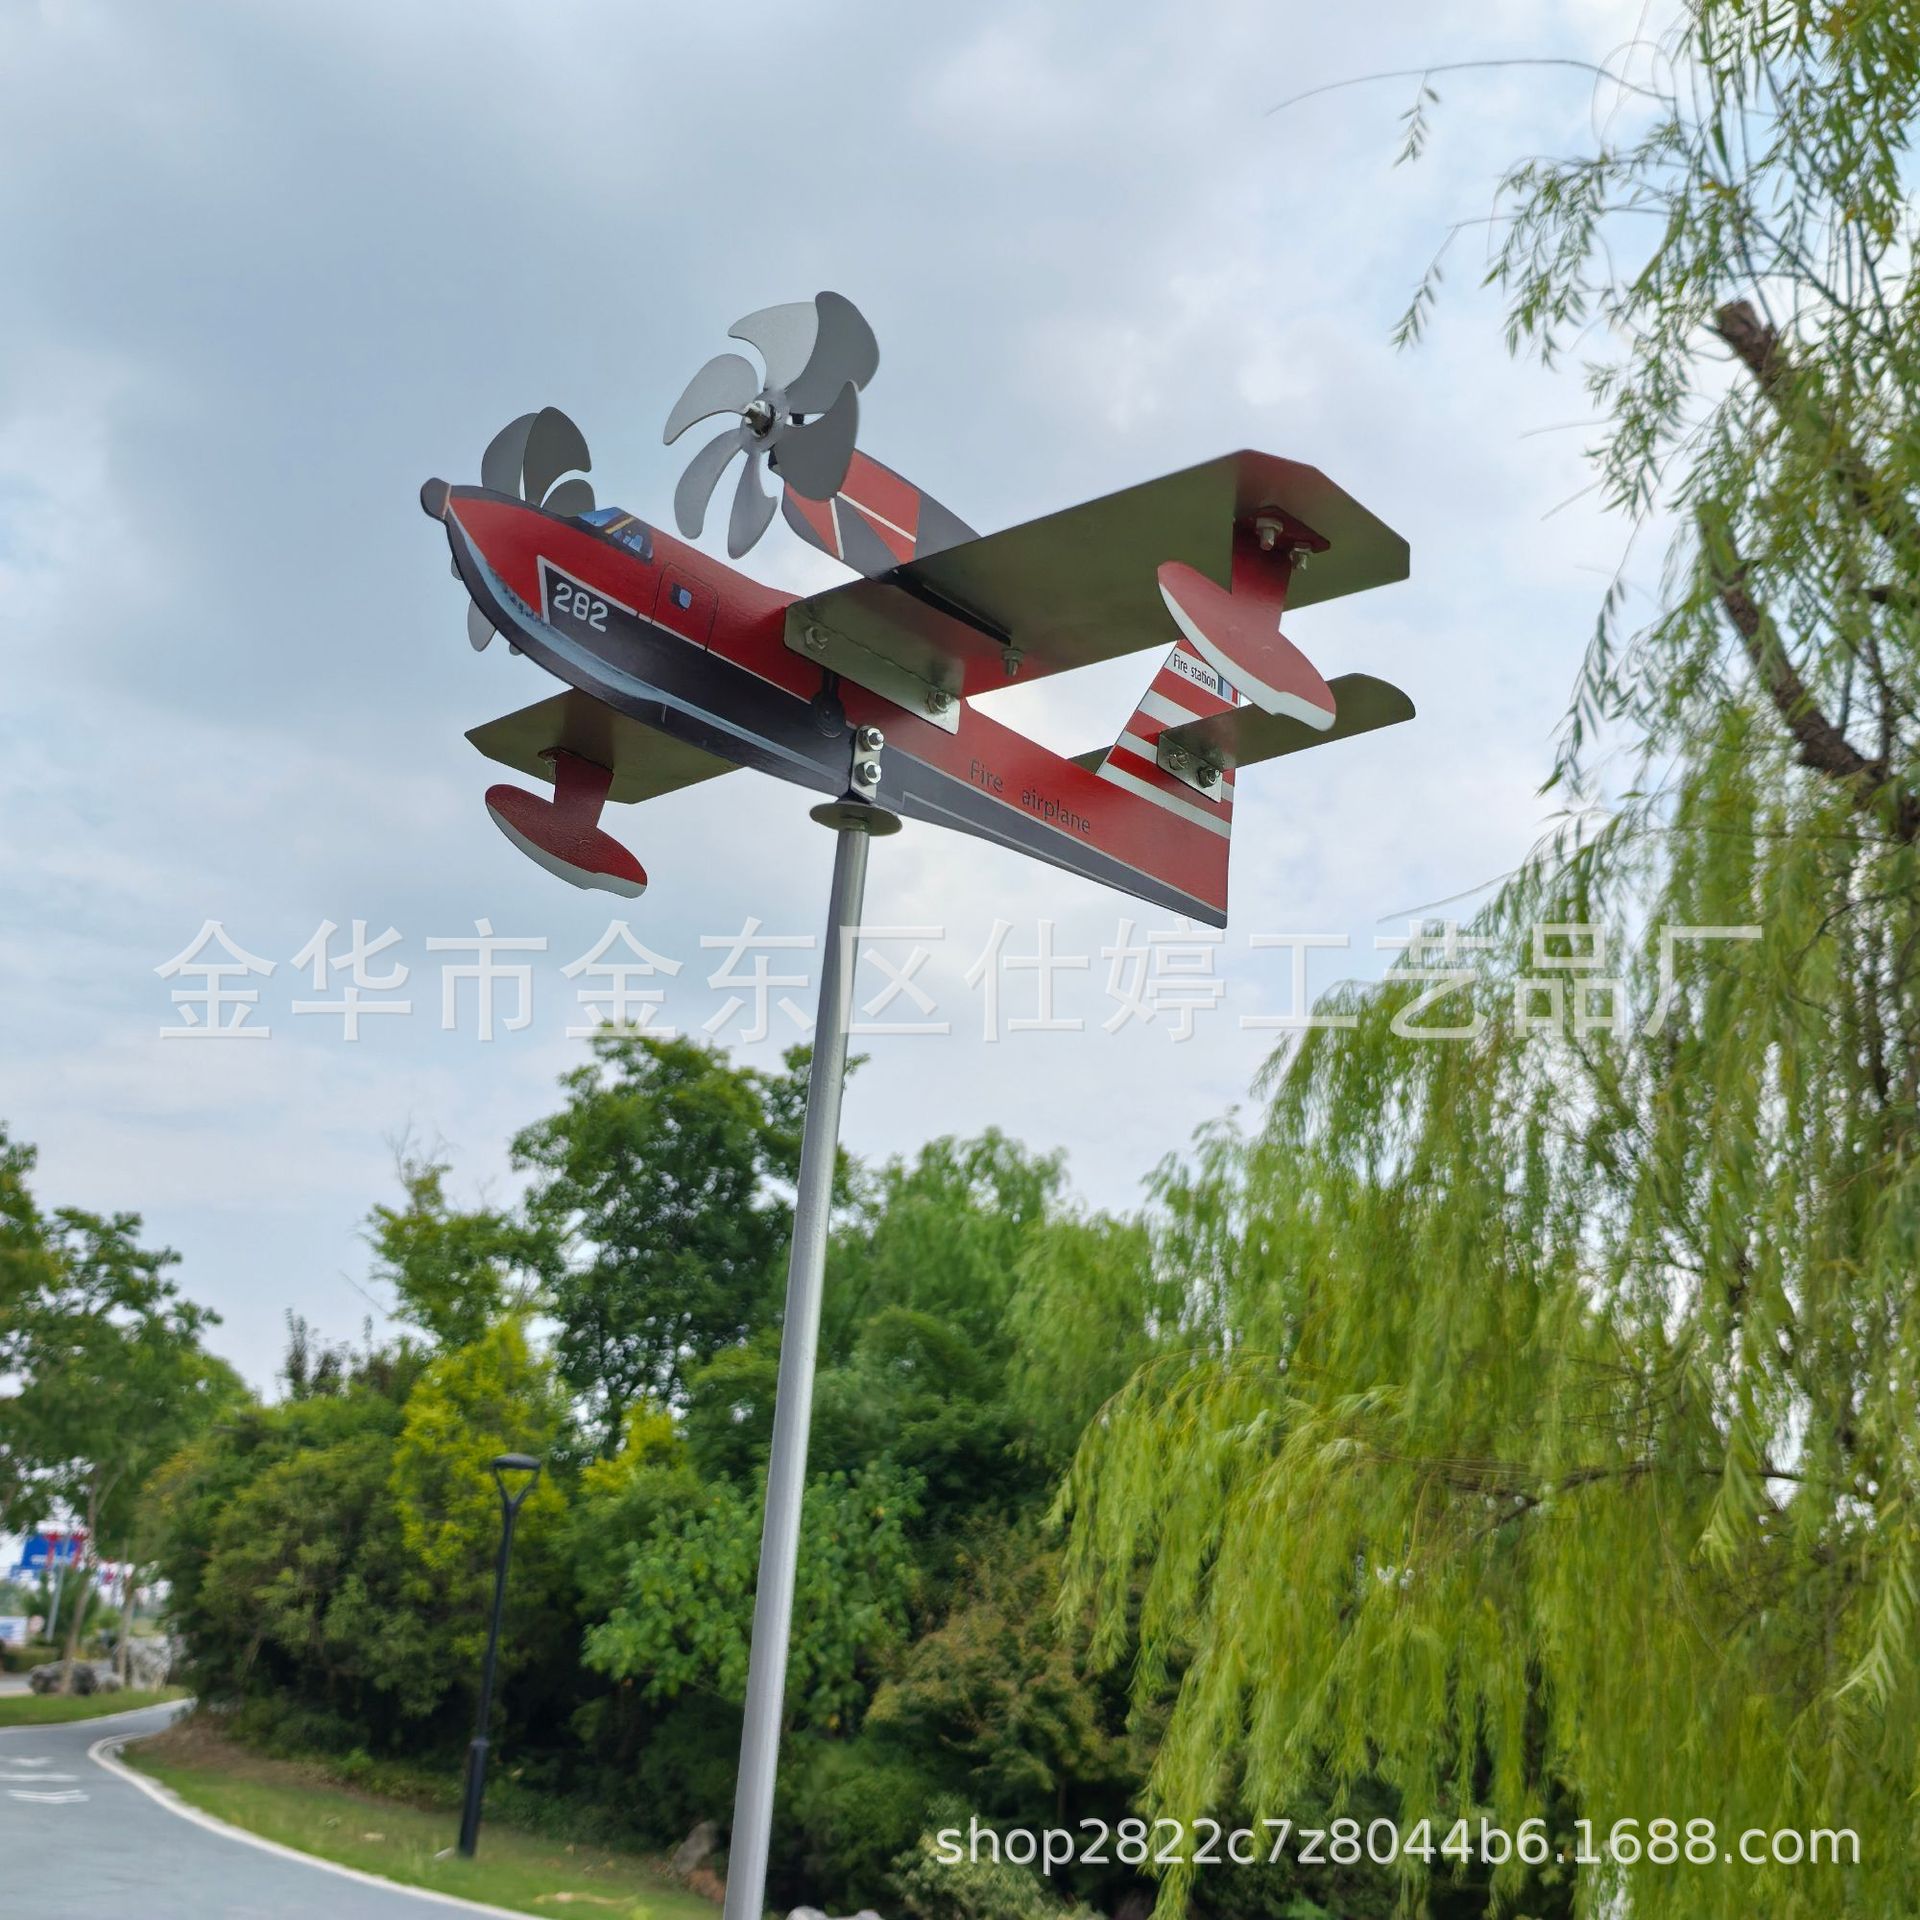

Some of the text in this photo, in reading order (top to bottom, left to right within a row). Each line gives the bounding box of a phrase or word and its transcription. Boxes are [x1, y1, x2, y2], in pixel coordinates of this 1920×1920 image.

[553, 582, 609, 633] 282
[1173, 653, 1217, 690] Fire station
[969, 759, 1091, 835] Fire airplane
